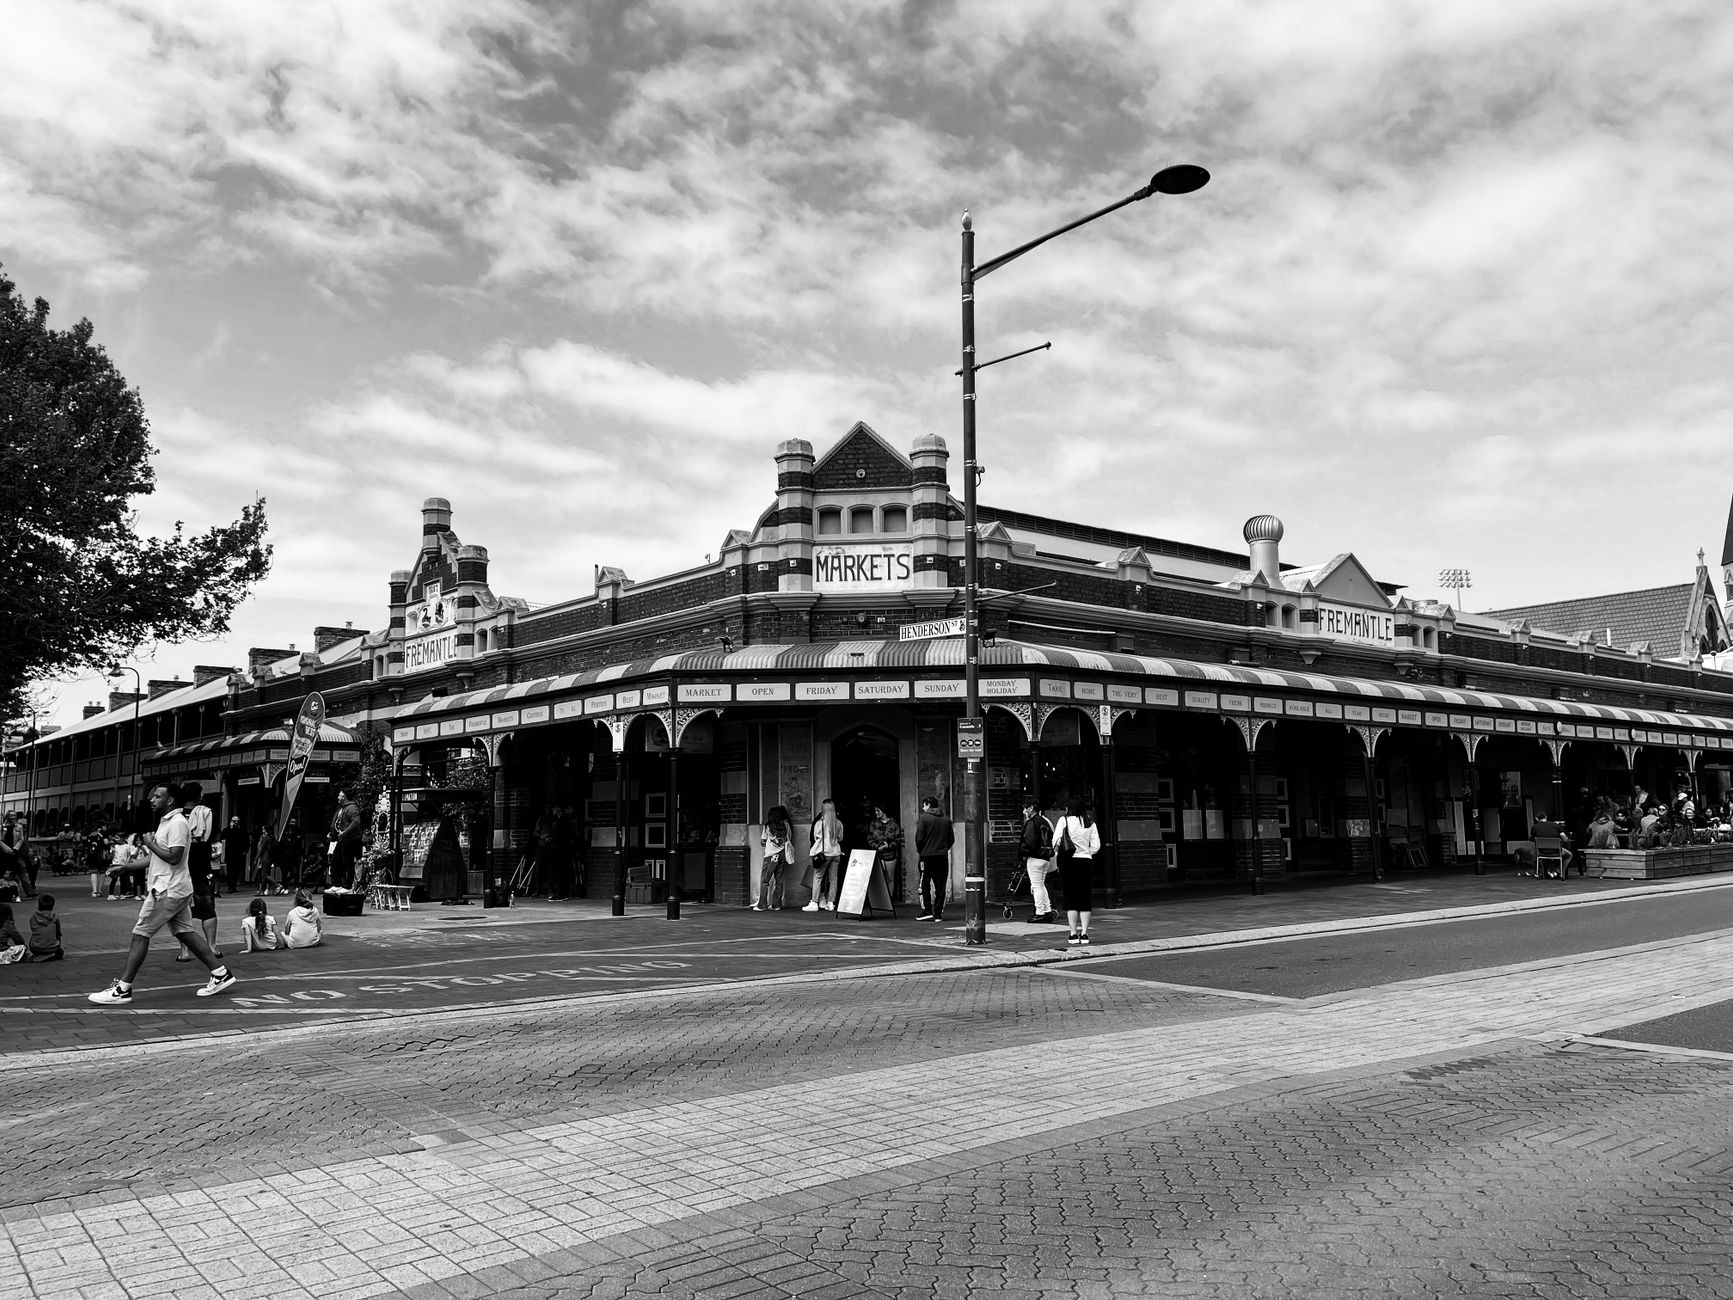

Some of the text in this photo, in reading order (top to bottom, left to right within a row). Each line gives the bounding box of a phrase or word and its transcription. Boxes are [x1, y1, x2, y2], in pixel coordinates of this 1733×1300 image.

[816, 553, 911, 583] MARKETS
[901, 621, 951, 640] HENDERSON
[1319, 608, 1393, 641] FREMANTLE
[685, 682, 960, 697] MARKET OPEN FRIDAY SATURDAY SUNDAY
[986, 687, 1018, 695] HOLIDAY
[229, 960, 692, 1008] NO STOPPING
